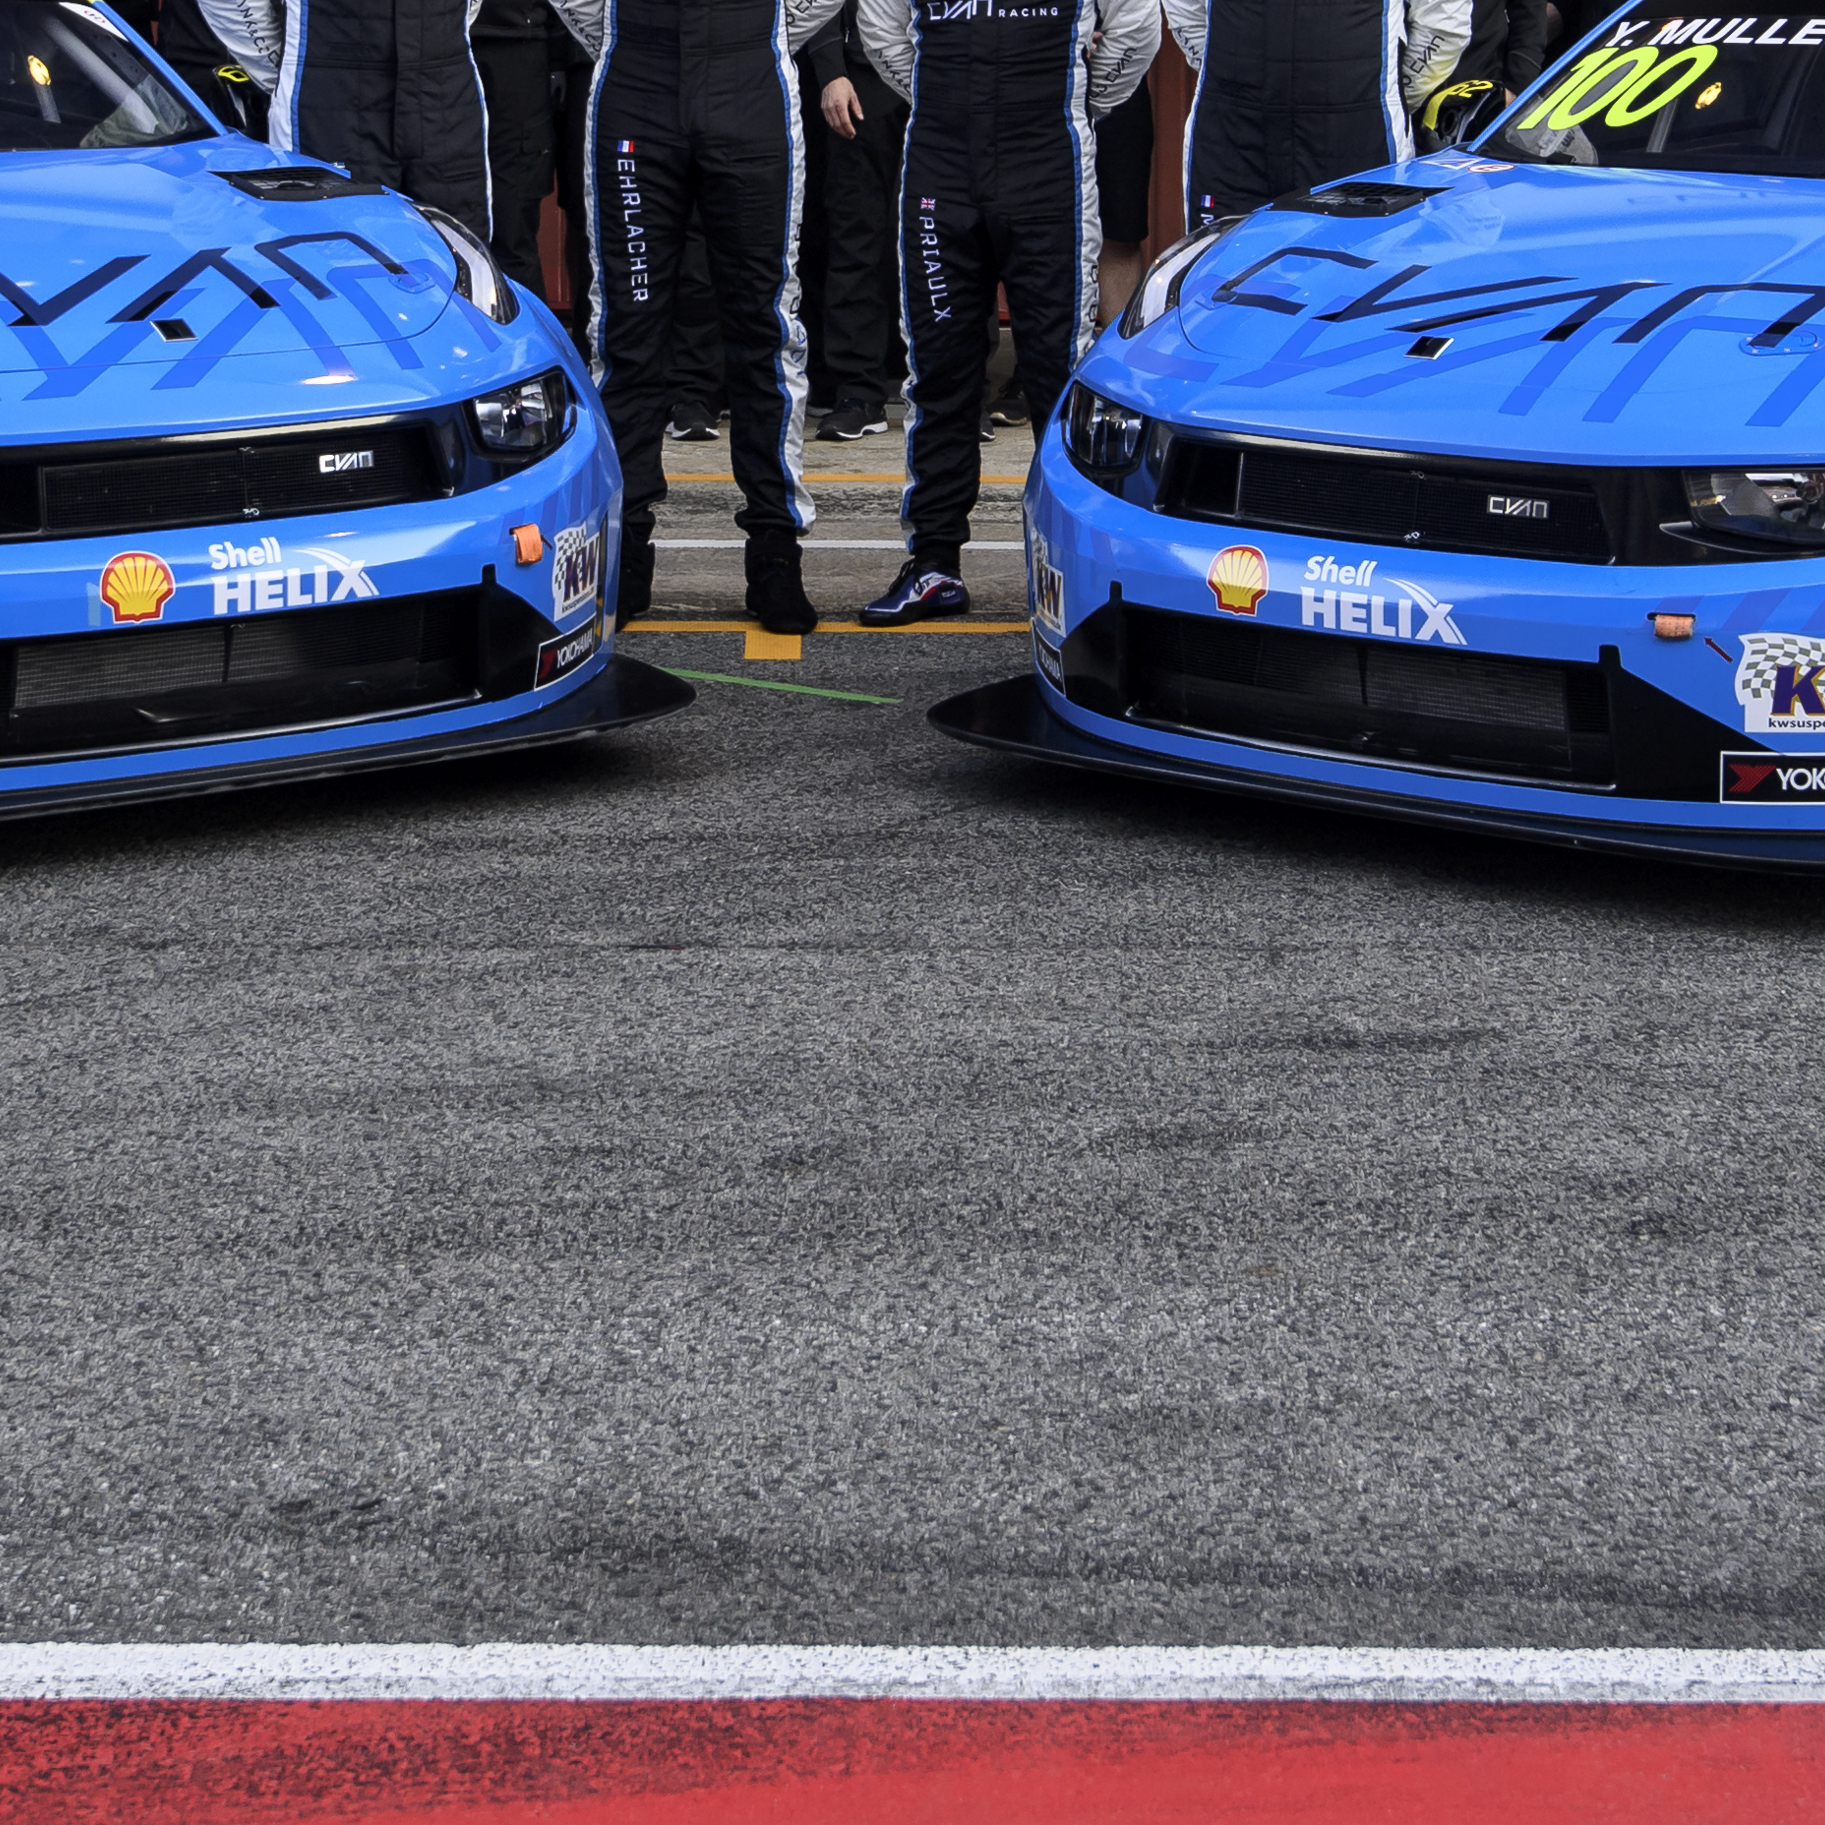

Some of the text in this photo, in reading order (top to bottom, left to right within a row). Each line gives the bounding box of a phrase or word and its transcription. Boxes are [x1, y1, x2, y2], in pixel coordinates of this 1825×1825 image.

[999, 7, 1058, 18] RACING
[1604, 20, 1633, 47] Y.
[1517, 44, 1719, 130] 100
[617, 159, 648, 302] EHRLACHER
[919, 217, 951, 322] PRIAULX
[319, 450, 374, 473] CYAN
[1488, 496, 1549, 518] CYAN
[208, 536, 282, 571] Shell
[563, 539, 600, 603] KW
[1304, 555, 1377, 587] Shell
[212, 554, 379, 615] HELIX
[1301, 577, 1468, 646] HELIX
[556, 627, 594, 670] YOKOHAMA
